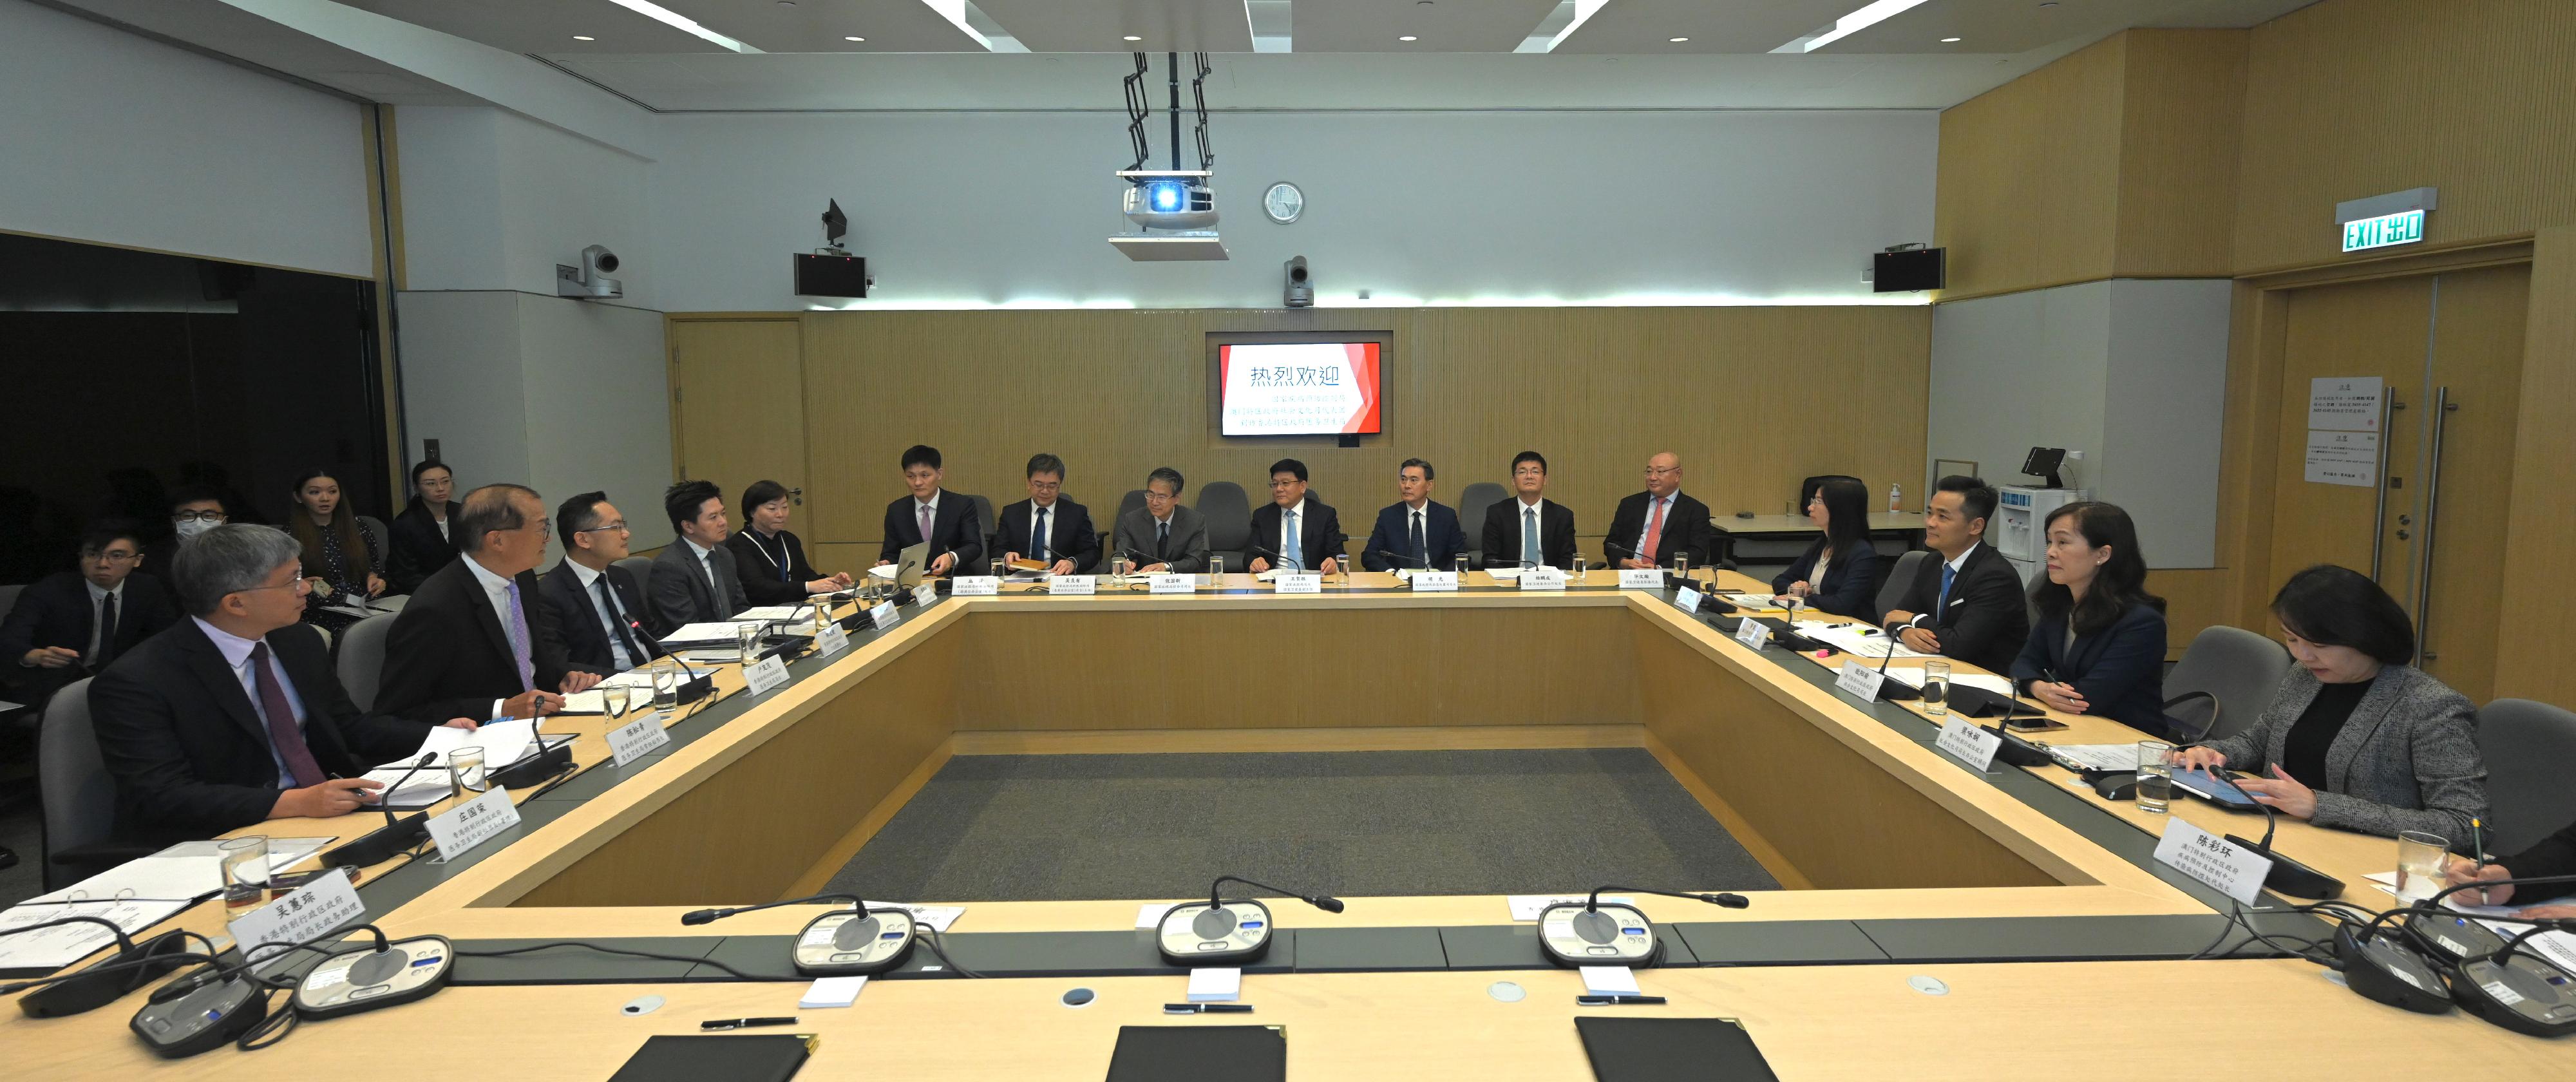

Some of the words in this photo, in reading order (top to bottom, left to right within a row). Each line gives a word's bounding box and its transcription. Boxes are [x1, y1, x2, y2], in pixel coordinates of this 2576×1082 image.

[2346, 219, 2385, 249] EXIT
[2387, 213, 2421, 242] 出口
[1251, 365, 1339, 386] 热烈欢迎
[453, 810, 502, 839] 香港特别行政区政府
[459, 803, 486, 823] 庄国荣
[2181, 842, 2239, 875] 澳门特别行政区政府
[2197, 834, 2233, 858] 陈彩环
[2177, 852, 2235, 883] 疾病预防及控制中心
[260, 895, 344, 944] 香港特别行政区政府
